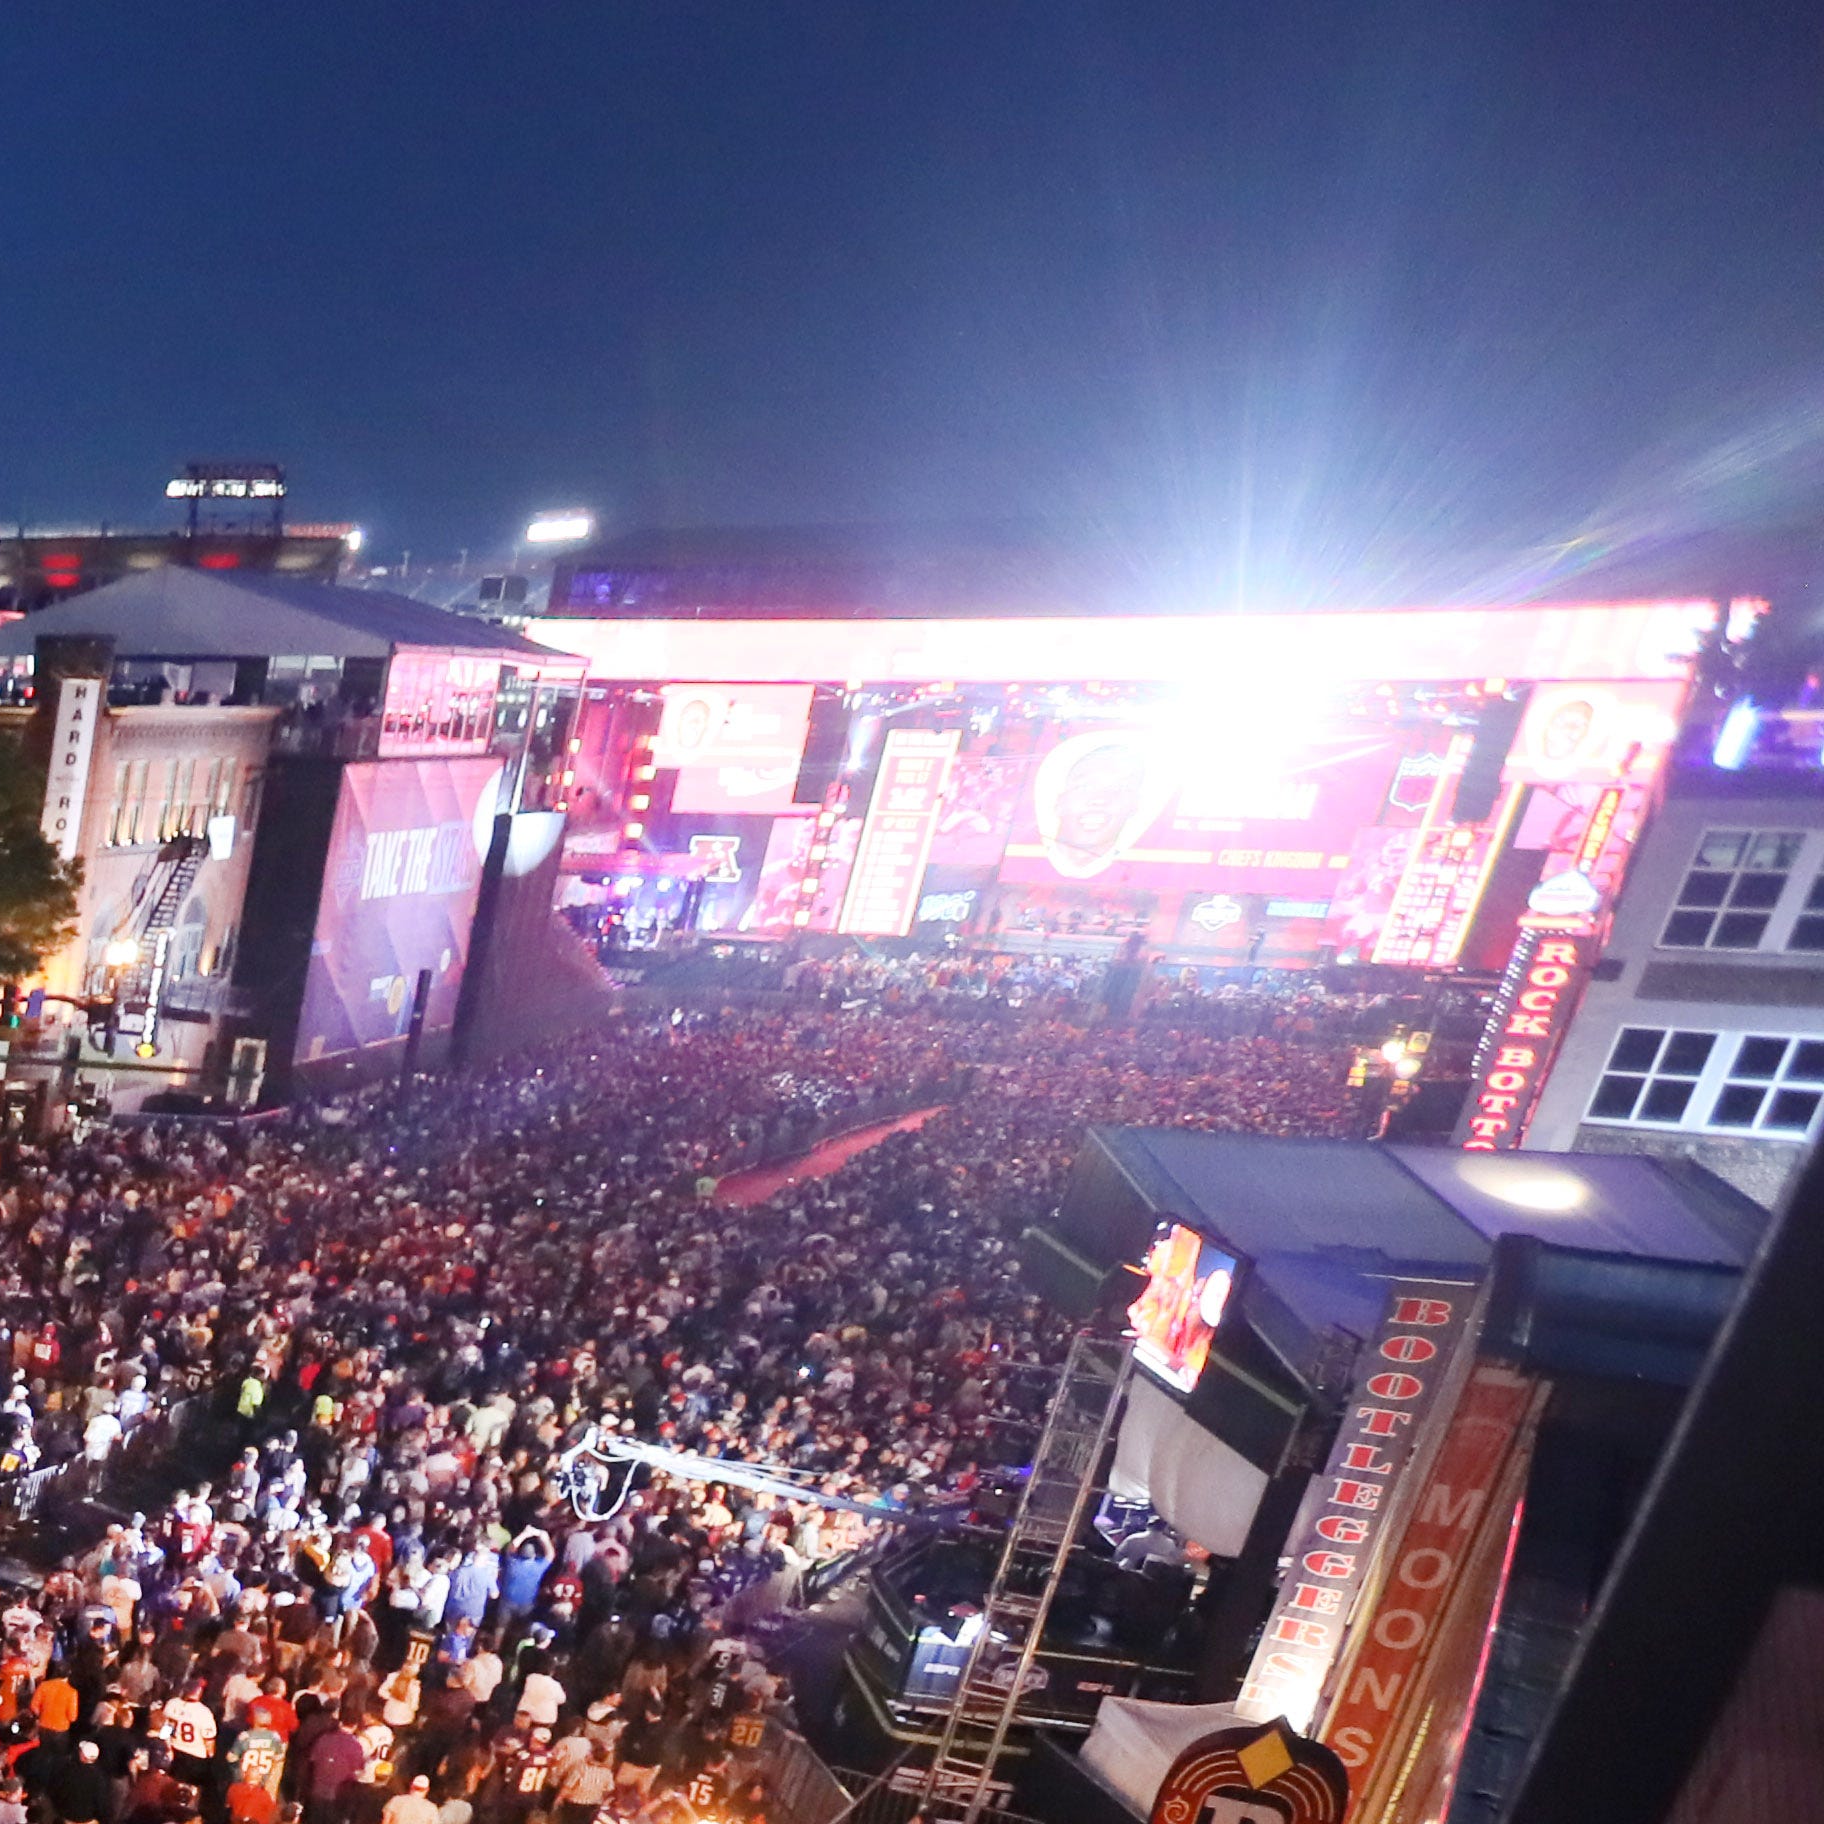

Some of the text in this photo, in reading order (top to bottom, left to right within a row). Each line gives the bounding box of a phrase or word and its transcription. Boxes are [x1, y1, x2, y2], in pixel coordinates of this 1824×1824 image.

[65, 686, 87, 766] HARD
[361, 831, 409, 900] TAKE
[400, 827, 439, 896] THE
[1505, 941, 1577, 1036] ROCK
[409, 1640, 430, 1664] 10
[923, 1662, 961, 1676] ESPN
[732, 1723, 764, 1748] 20
[519, 1767, 548, 1793] 81
[689, 1780, 713, 1805] 15
